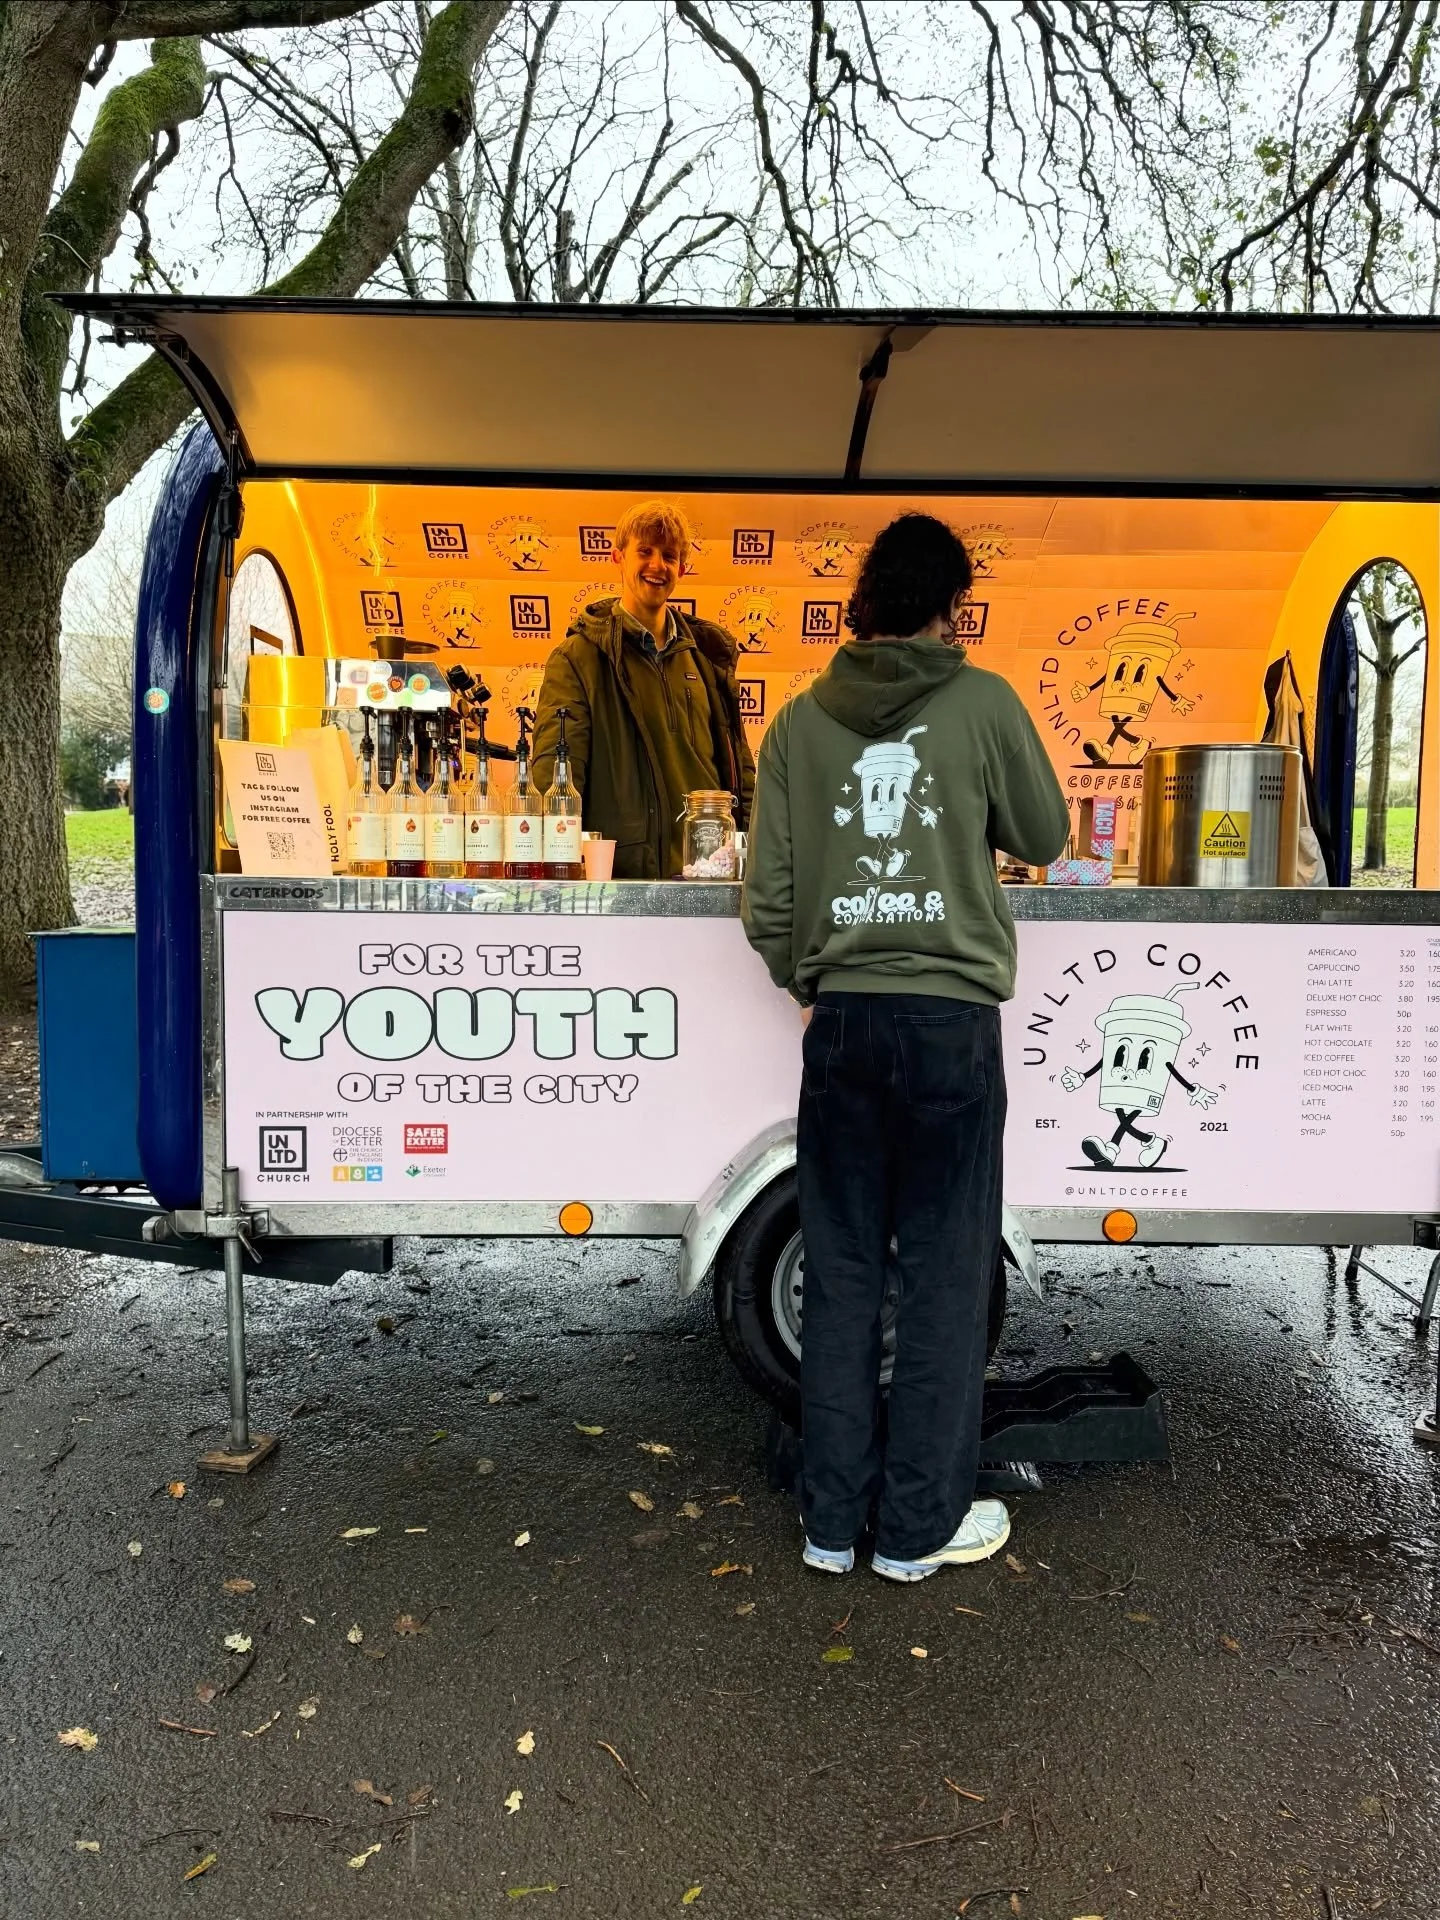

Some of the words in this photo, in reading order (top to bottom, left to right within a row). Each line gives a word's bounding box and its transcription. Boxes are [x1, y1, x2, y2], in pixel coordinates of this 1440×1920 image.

[431, 528, 449, 536] UN
[587, 530, 604, 539] UN
[433, 537, 458, 546] LTD
[742, 534, 758, 542] UN
[588, 540, 612, 550] LTD
[740, 543, 764, 552] LTD
[426, 580, 466, 600] COFFEE
[574, 582, 616, 602] COFFEE
[724, 586, 766, 606] COFFEE
[518, 602, 534, 613] UN
[810, 608, 827, 618] UN
[518, 614, 542, 624] LTD
[810, 618, 832, 630] LTD
[1058, 598, 1170, 646] COFFEE
[1039, 657, 1081, 746] UNLTD
[1068, 775, 1143, 790] COFFEE
[250, 804, 300, 813] INSTAGRAM
[282, 816, 311, 824] COFFEE
[323, 804, 336, 832] FOOL
[1096, 803, 1115, 835] TACO
[328, 834, 340, 862] HOLY
[1204, 838, 1246, 848] Caution
[924, 890, 944, 912] &
[1308, 948, 1357, 956] AMERICANO
[358, 942, 464, 976] FOR
[476, 944, 582, 977] THE
[1308, 964, 1360, 972] CAPPUCCINO
[1306, 994, 1338, 1002] DELUXE
[1340, 994, 1356, 1002] HOT
[1358, 994, 1382, 1002] CHOC
[1024, 948, 1117, 1066] UNLTD
[1147, 944, 1259, 1070] COFFEE
[1306, 1008, 1346, 1016] ESPRESSO
[1397, 1010, 1412, 1018] 50p
[254, 986, 678, 1062] YOUTH
[1304, 1039, 1322, 1047] HOT
[337, 1072, 404, 1102] OF
[416, 1074, 512, 1104] THE
[523, 1074, 639, 1104] CITY
[1302, 1098, 1326, 1106] LATTE
[1035, 1118, 1060, 1129] EST.
[1200, 1122, 1228, 1132] 2021
[332, 1126, 382, 1136] DIOCESE
[406, 1128, 444, 1137] SAFER
[1390, 1130, 1406, 1138] 50p
[268, 1134, 288, 1149] UN
[340, 1136, 382, 1146] EXETER
[406, 1138, 444, 1146] EXETER
[268, 1150, 297, 1164] LTD
[423, 1166, 446, 1174] Exeter
[257, 1174, 310, 1182] CHURCH
[1065, 1186, 1188, 1198] @UNLTDCOFFEE
